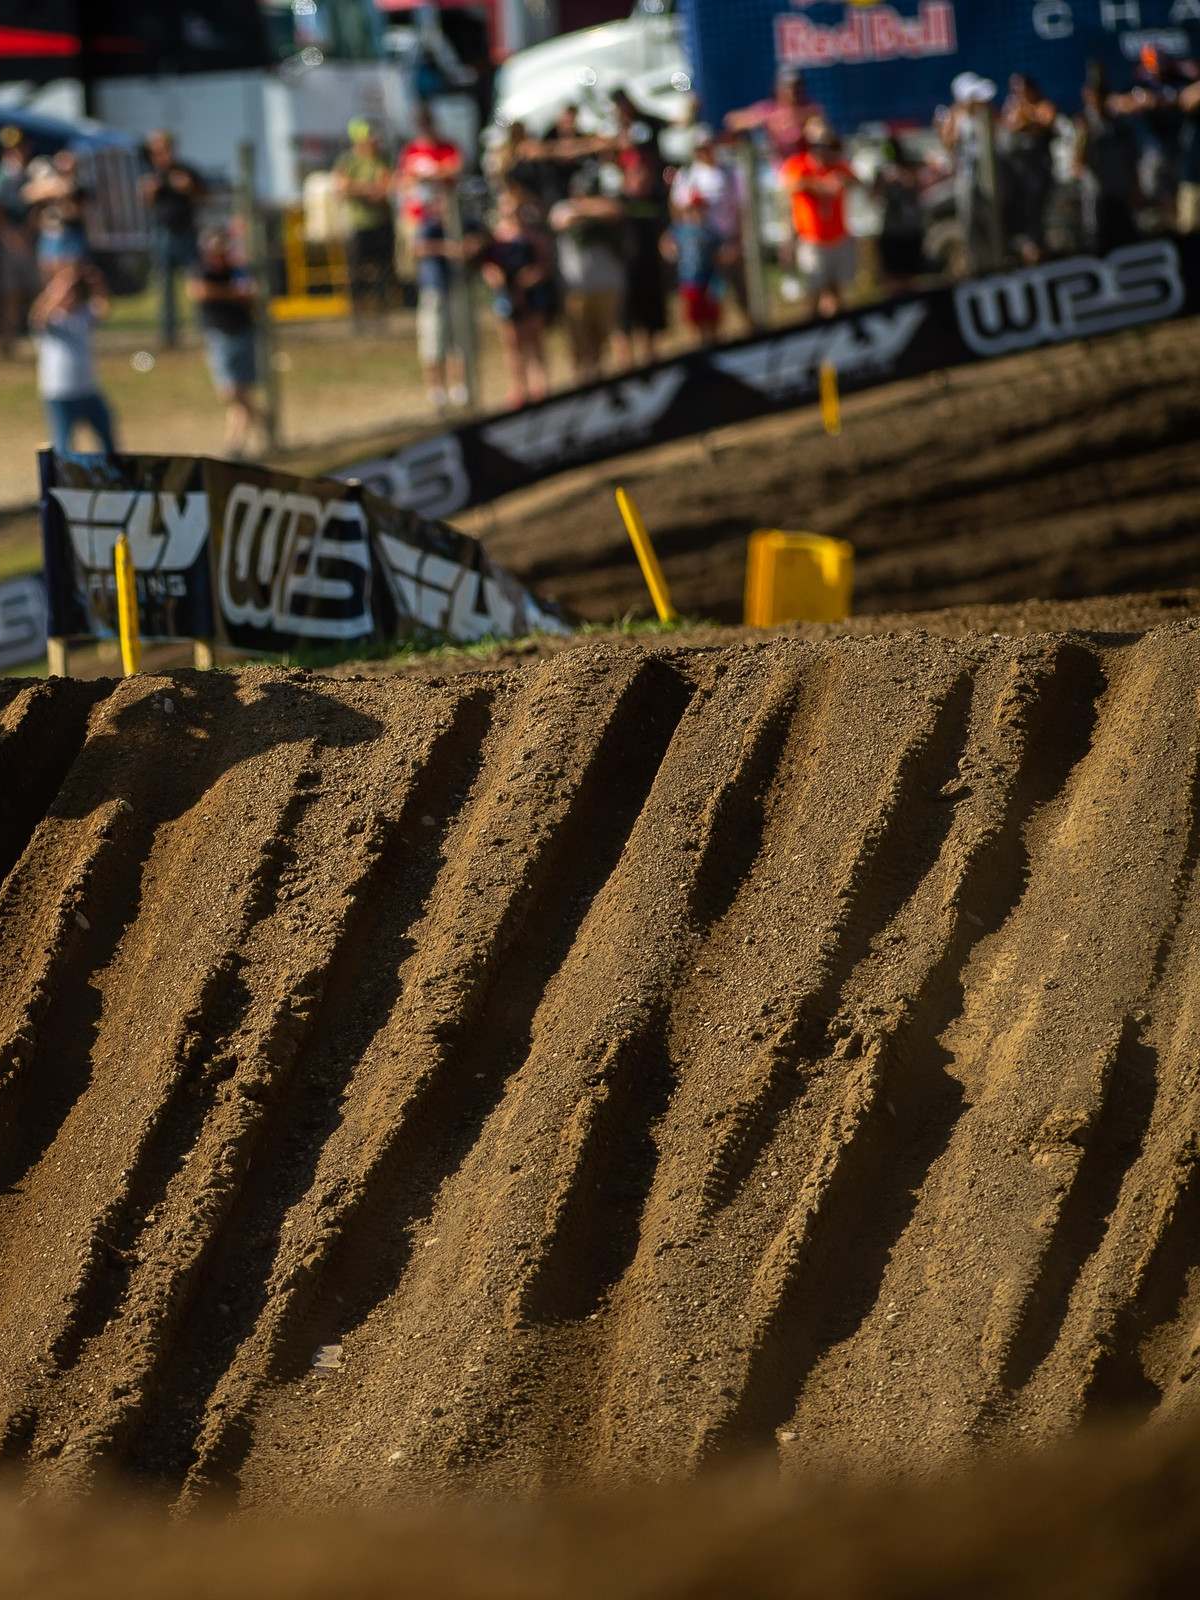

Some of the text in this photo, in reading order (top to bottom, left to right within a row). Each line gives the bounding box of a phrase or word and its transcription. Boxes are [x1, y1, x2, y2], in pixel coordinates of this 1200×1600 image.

[775, 1, 957, 67] Red Bull
[954, 239, 1185, 357] WPS
[48, 487, 210, 571] FLY
